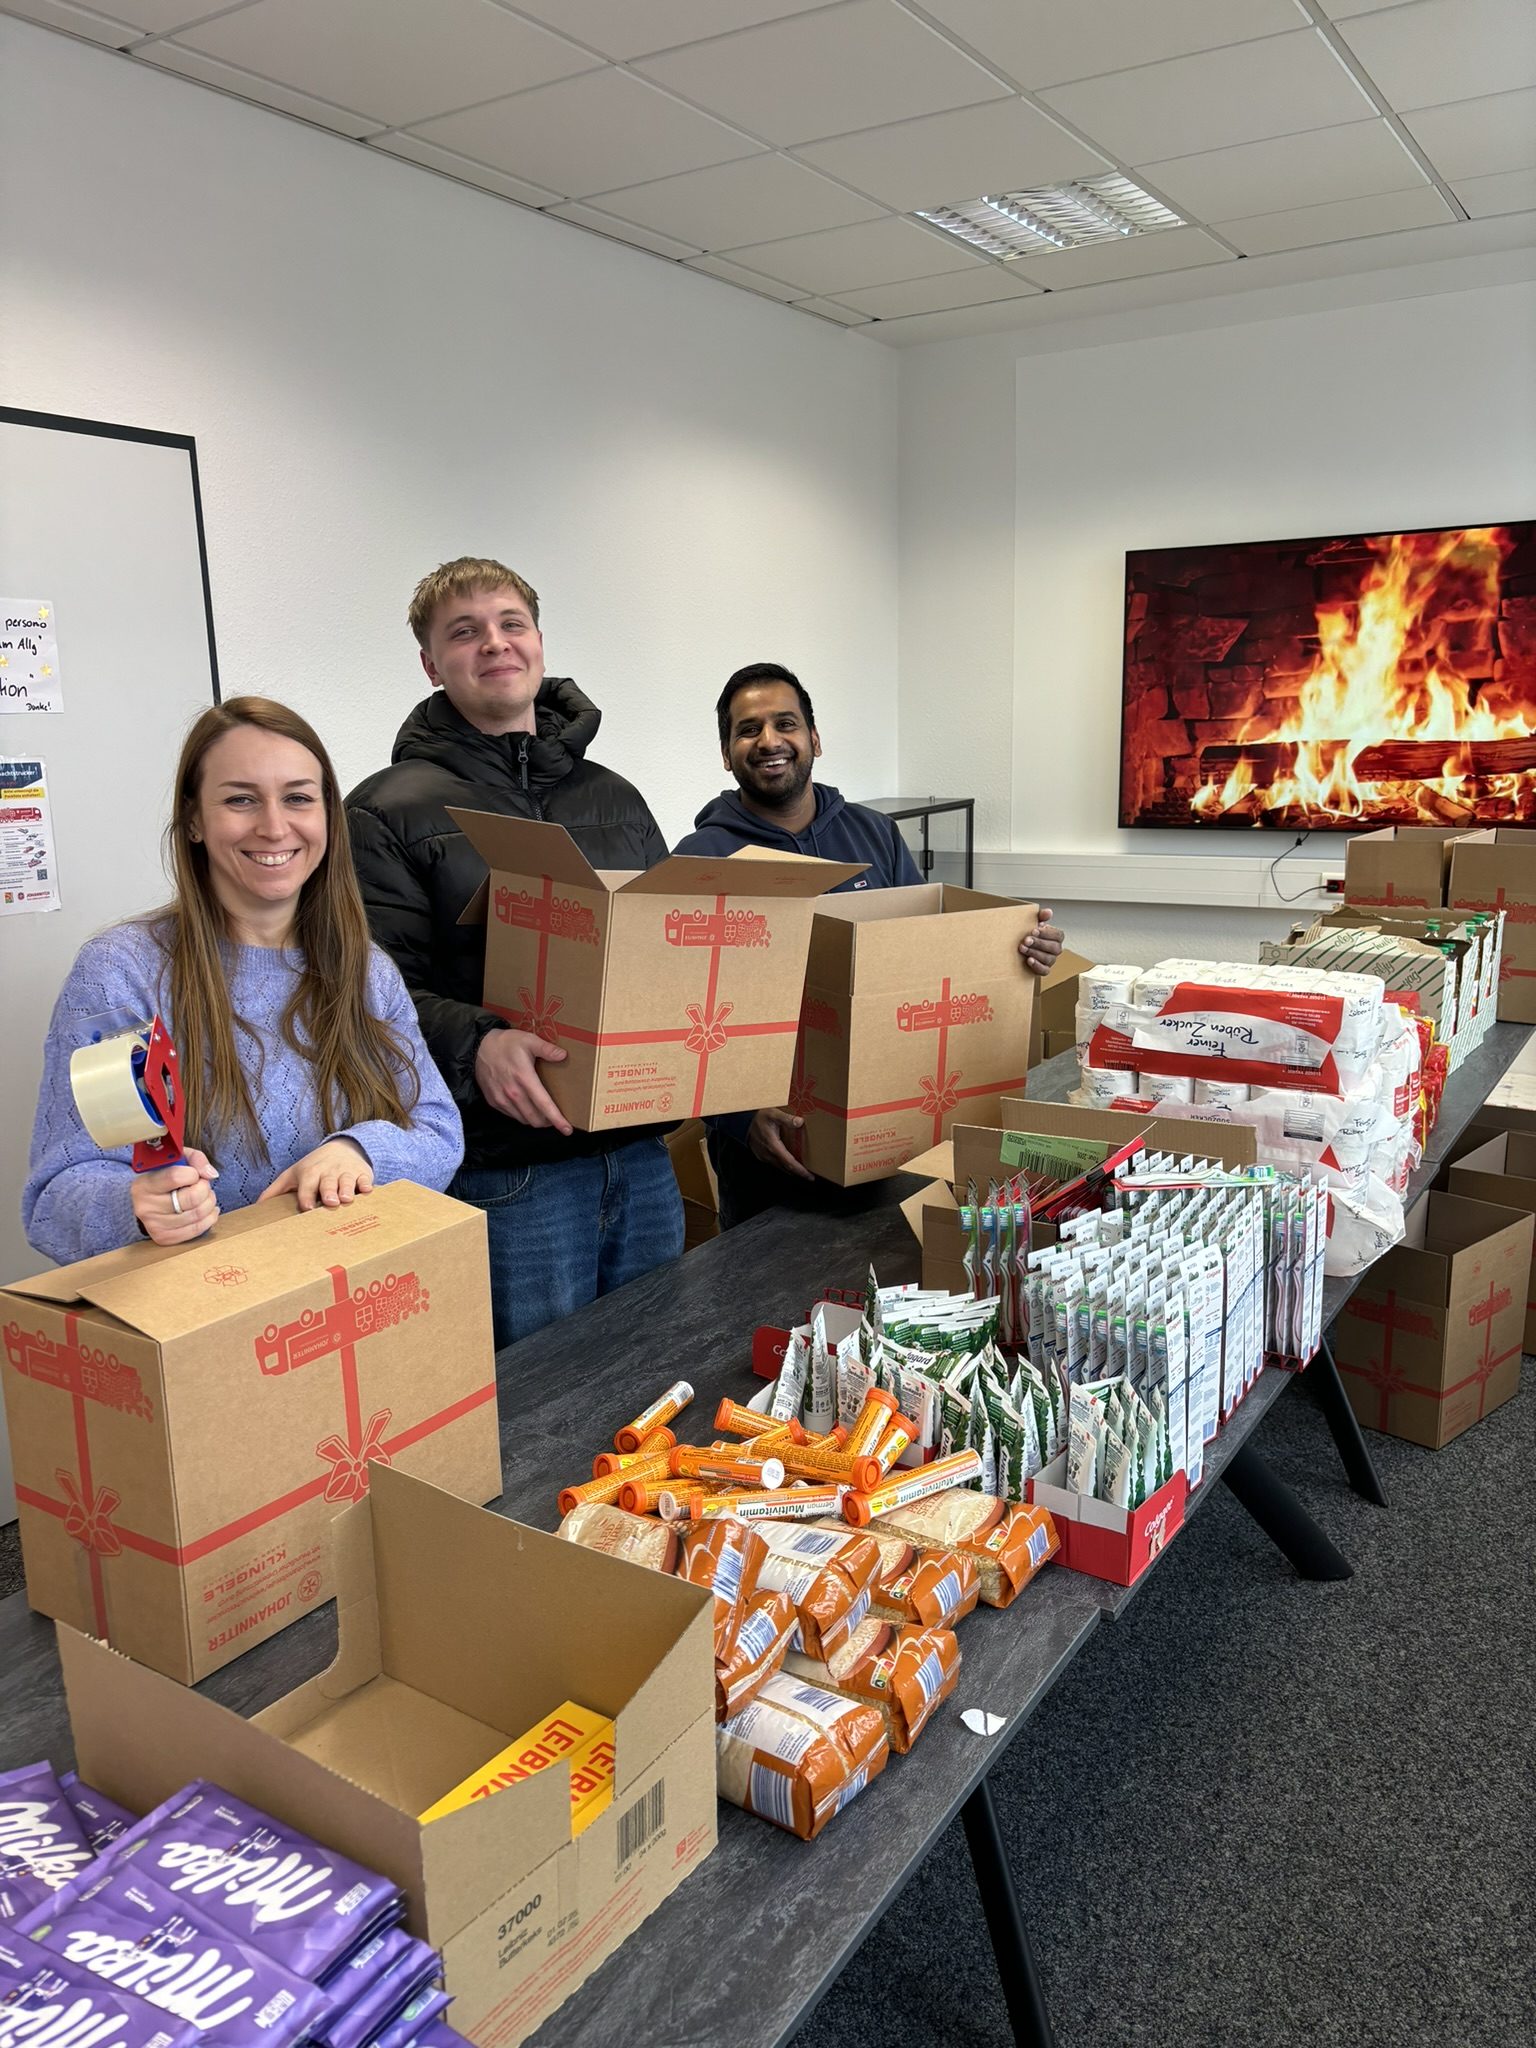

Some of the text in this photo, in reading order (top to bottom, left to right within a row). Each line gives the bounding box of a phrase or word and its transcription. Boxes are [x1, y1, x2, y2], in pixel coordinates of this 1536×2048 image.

[1160, 1018, 1260, 1045] Rüben Zucker
[1186, 1037, 1229, 1059] Feiner
[607, 1066, 658, 1079] KLINGELE
[603, 1099, 656, 1114] JOHANNITER
[292, 1337, 330, 1361] JOHANNITER
[900, 1477, 955, 1503] Multivitamin
[1144, 1497, 1174, 1538] Colgate
[203, 1549, 287, 1603] KLINGELE
[207, 1590, 293, 1653] JOHANNITER
[158, 1842, 333, 1923] Milka
[497, 1893, 542, 1941] 37000
[62, 1930, 255, 2031] Milka
